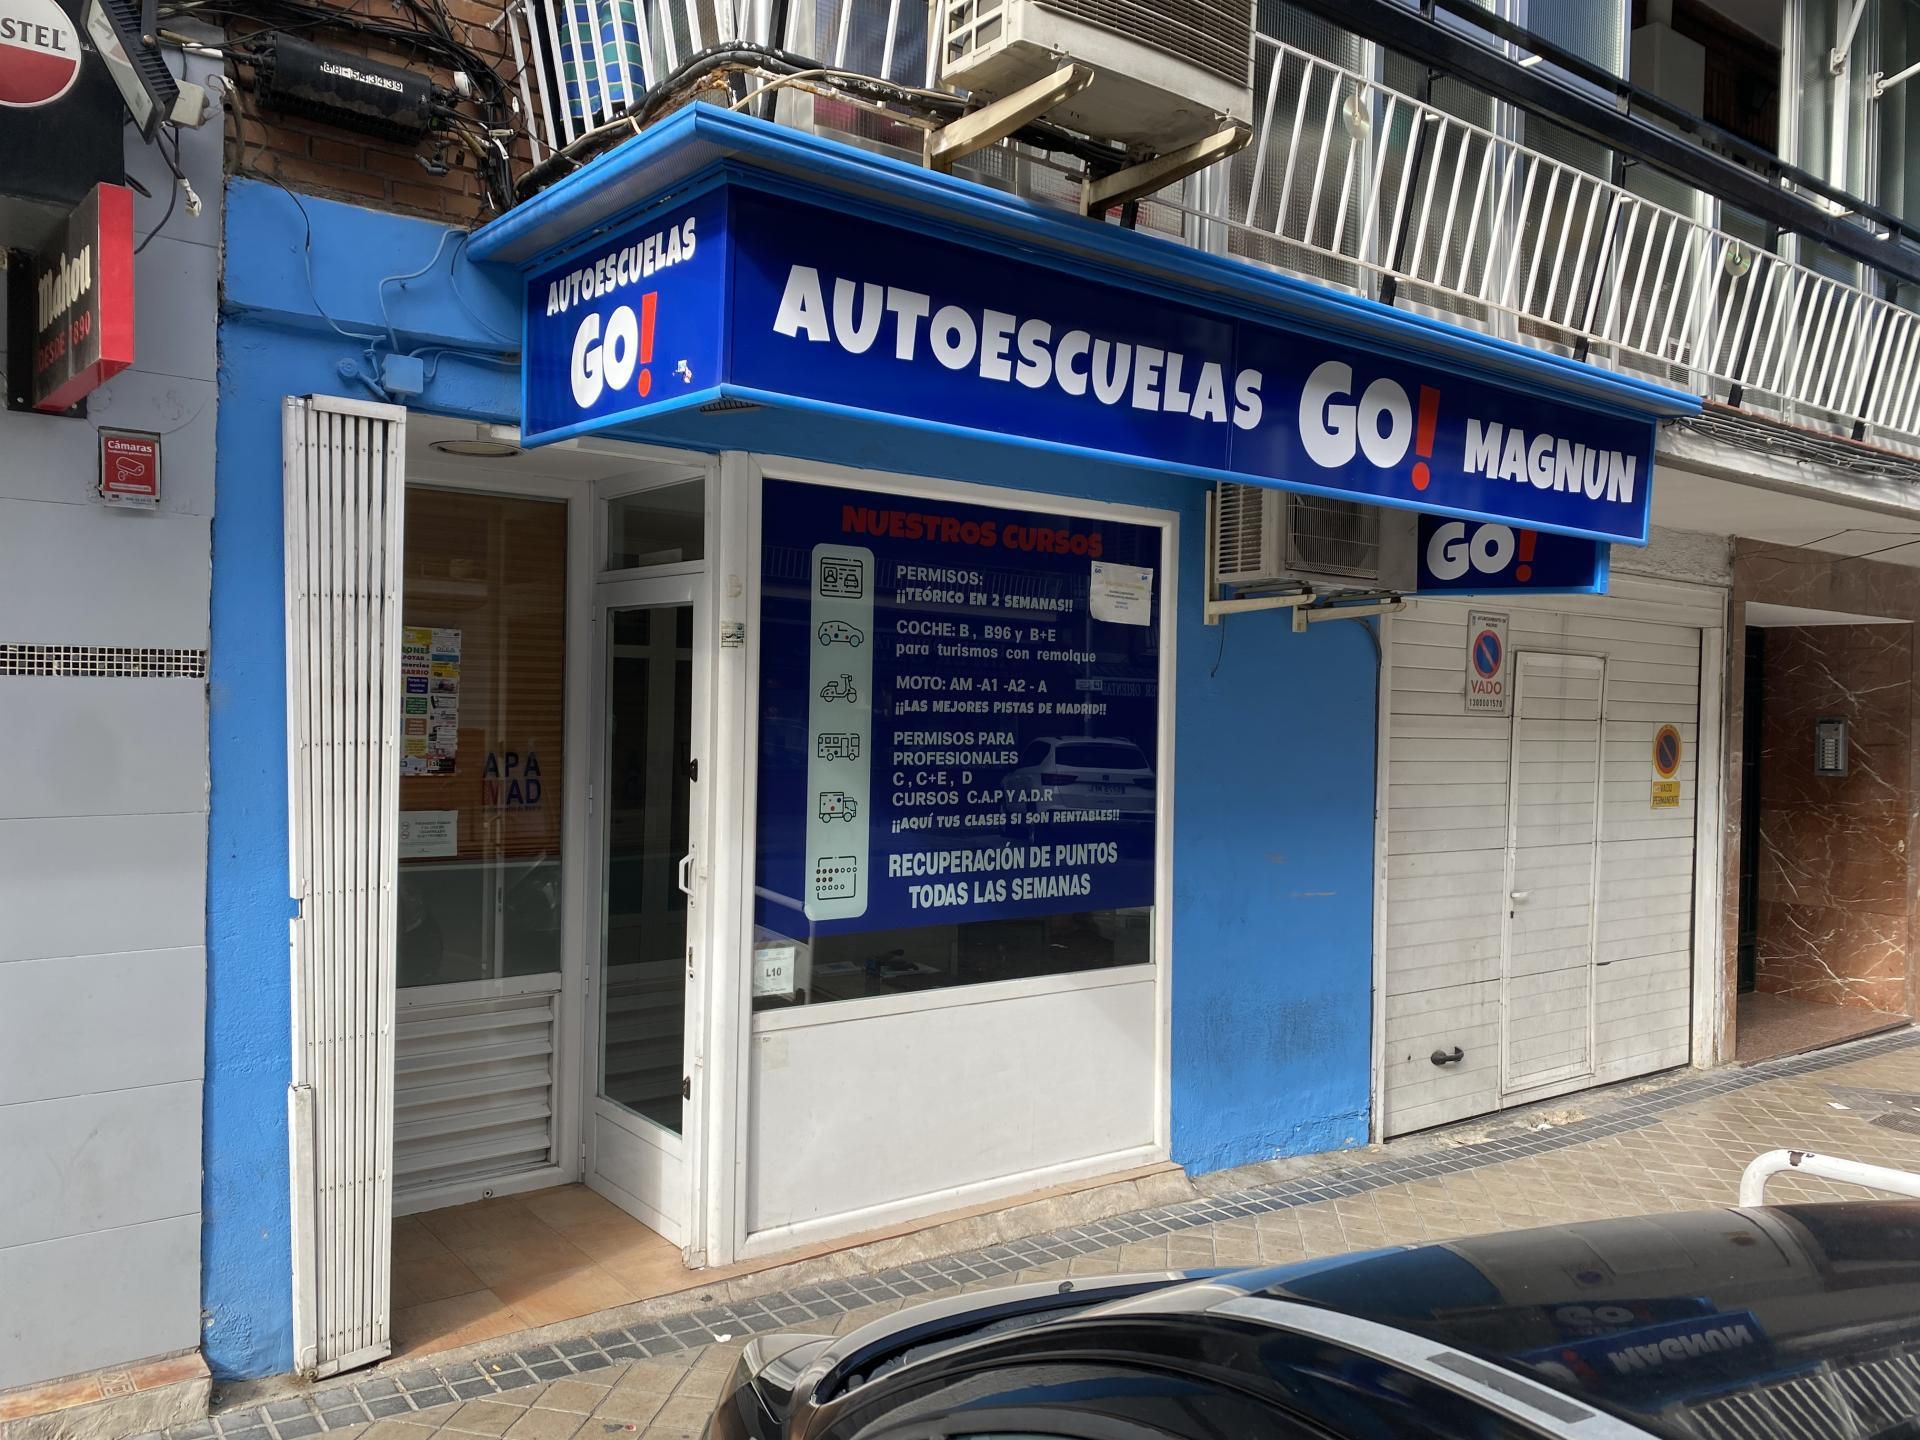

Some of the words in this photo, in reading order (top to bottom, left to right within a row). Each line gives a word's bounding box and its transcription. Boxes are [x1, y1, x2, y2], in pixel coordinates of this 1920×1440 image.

[0, 17, 66, 51] STEL
[546, 216, 696, 316] AUTOESCUELAS
[38, 244, 91, 334] Mahou
[570, 291, 658, 409] GO!
[772, 264, 1264, 431] AUTOESCUELAS
[1298, 360, 1441, 491] GO!
[1463, 417, 1637, 503] MAGNUN
[107, 440, 152, 453] Cámaras
[841, 505, 999, 548] NUESTROS
[1002, 524, 1104, 558] CURSOS
[1426, 521, 1538, 582] GO!
[896, 564, 984, 586] PERMISOS:
[896, 585, 965, 605] ¡¡TEÓRICO
[969, 591, 987, 607] EN
[991, 594, 1000, 607] 2
[1004, 596, 1074, 613] SEMANAS!!
[896, 619, 956, 638] COCHE:
[984, 625, 1012, 640] B96
[1015, 628, 1023, 643] y
[1030, 628, 1057, 642] B+E
[896, 643, 930, 657] para
[937, 643, 998, 658] turismos
[1006, 648, 1030, 660] con
[1037, 649, 1096, 664] remolque
[896, 675, 946, 690] MOTO:
[950, 677, 973, 691] AM
[1038, 679, 1047, 693] A
[1471, 680, 1503, 695] VADO
[895, 700, 928, 715] ¡¡LAS
[932, 701, 989, 713] MEJORES
[993, 702, 1034, 714] PISTAS
[1038, 703, 1052, 714] DE
[1056, 703, 1107, 715] MADRID!!
[893, 732, 974, 745] PERMISOS
[978, 732, 1015, 745] PARA
[893, 751, 1019, 766] PROFESIONALES
[962, 771, 973, 785] D
[892, 791, 959, 807] CURSOS
[967, 790, 1003, 804] C.A.P
[1006, 790, 1015, 802] Y
[1018, 789, 1053, 802] A.D.R
[891, 812, 934, 834] ¡¡AQUÍ
[937, 815, 961, 828] TUS
[964, 813, 1007, 827] CLASES
[1010, 813, 1022, 825] SI
[1025, 811, 1050, 824] SON
[1053, 809, 1120, 823] RENTABLES!!
[888, 842, 1025, 878] RECUPERACIÓN
[1029, 845, 1051, 868] DE
[1055, 841, 1118, 866] PUNTOS
[908, 881, 968, 909] TODAS
[973, 879, 1007, 904] LAS
[1011, 873, 1091, 901] SEMANAS
[766, 967, 782, 977] L10
